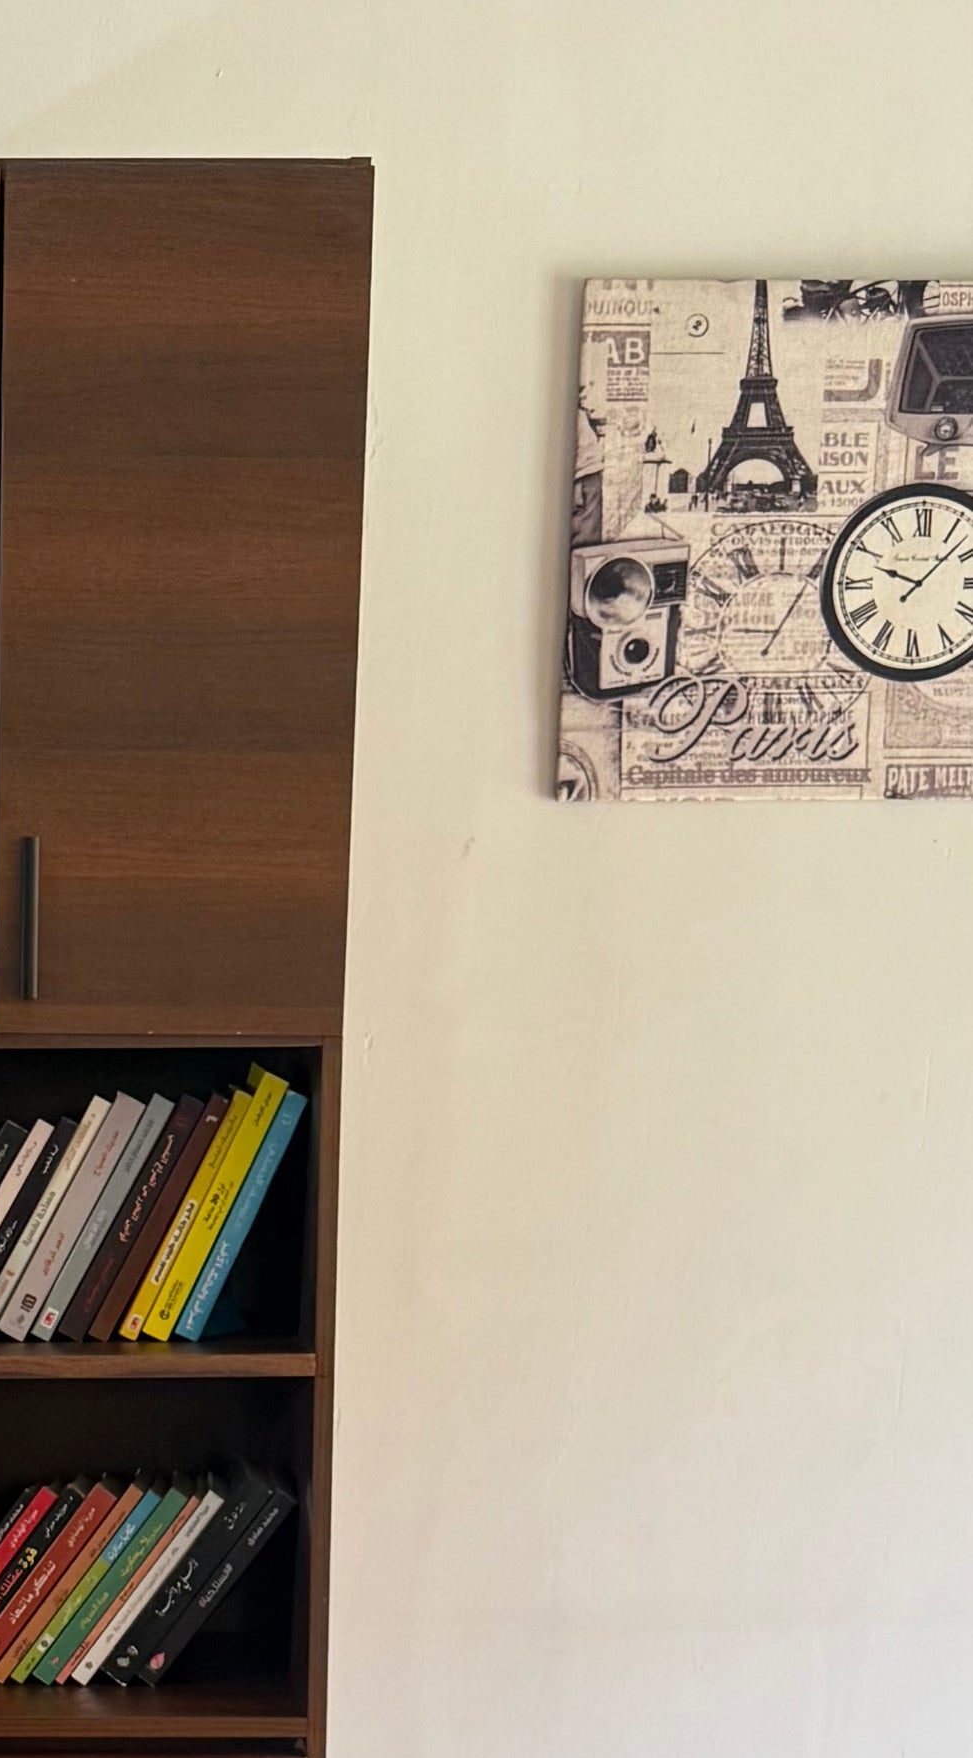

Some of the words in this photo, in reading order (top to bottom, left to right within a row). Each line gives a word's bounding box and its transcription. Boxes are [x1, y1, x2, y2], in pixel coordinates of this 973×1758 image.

[821, 432, 869, 448] BLE
[819, 452, 868, 466] ISON
[914, 509, 932, 537] XII
[648, 674, 859, 762] Paris
[628, 765, 715, 789] Capitale
[721, 765, 756, 783] des
[762, 767, 872, 783] amoureux
[209, 1193, 220, 1205] 20
[14, 1543, 42, 1572] قوة
